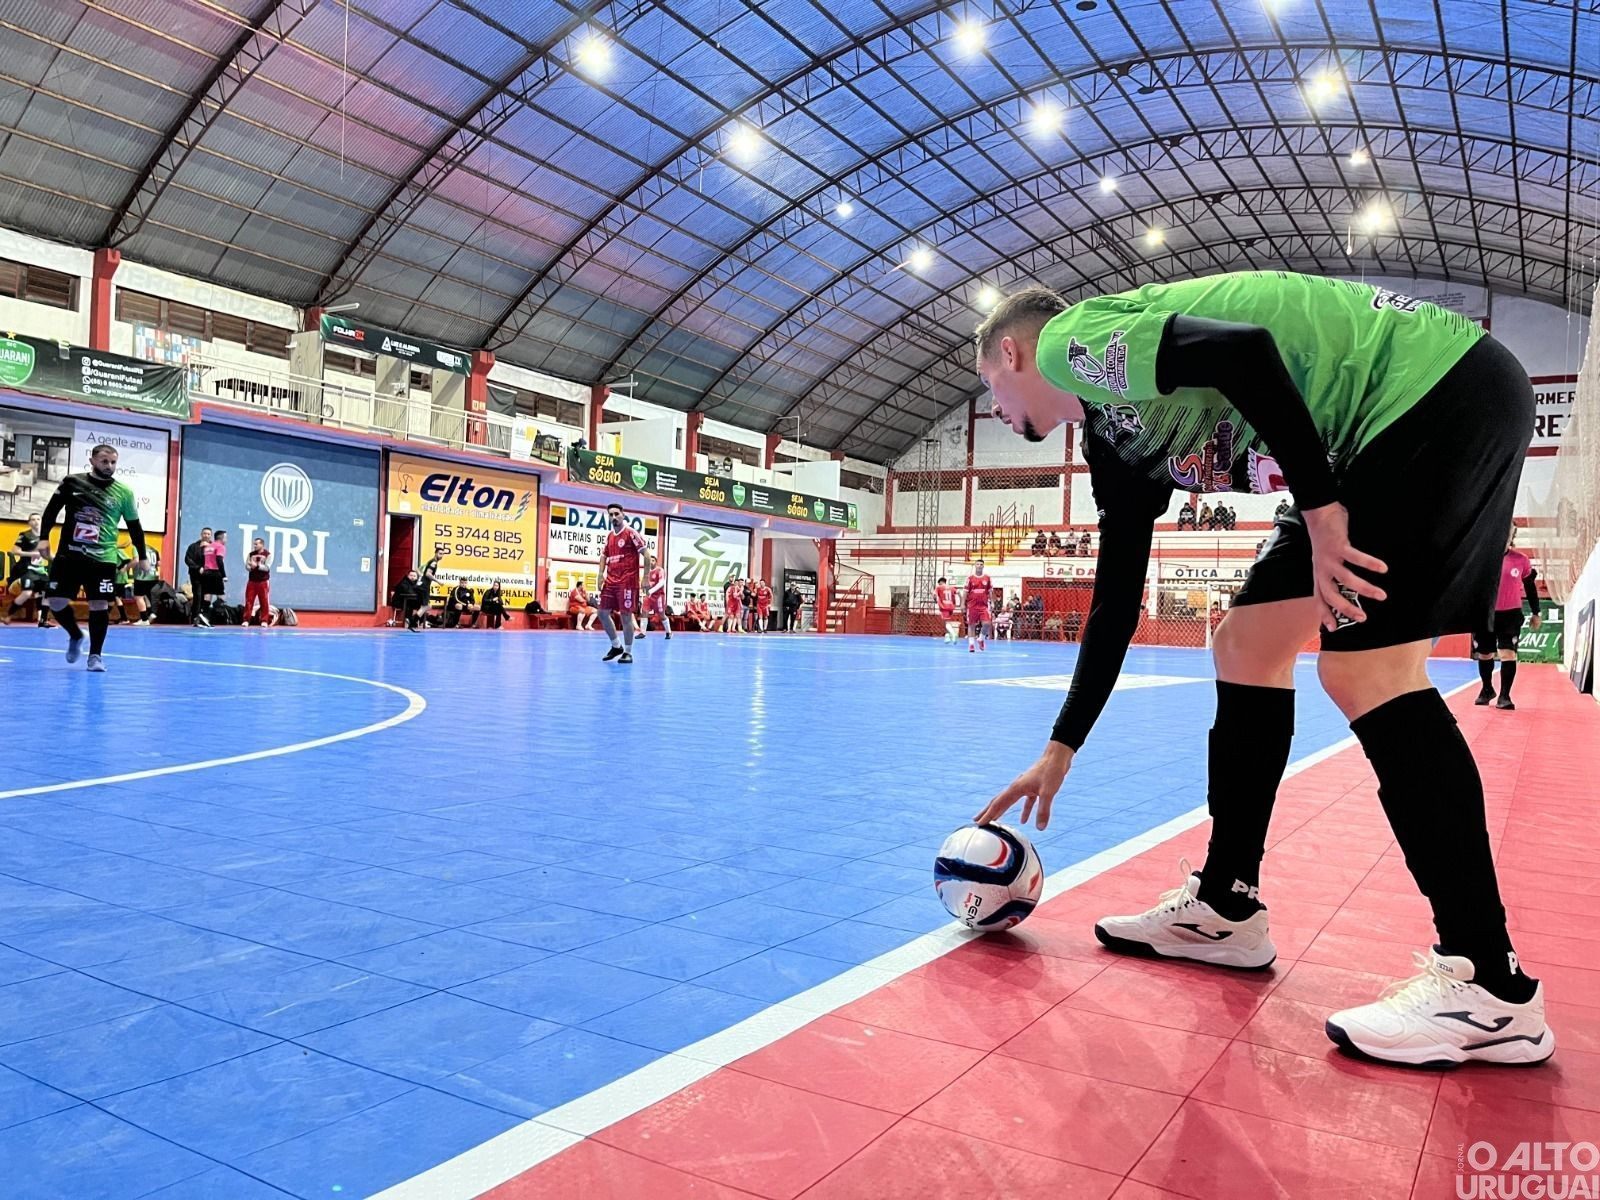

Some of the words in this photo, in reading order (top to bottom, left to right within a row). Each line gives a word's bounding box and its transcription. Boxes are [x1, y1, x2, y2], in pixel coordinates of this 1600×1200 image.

[86, 431, 96, 442] A
[97, 436, 128, 447] gente
[130, 440, 152, 451] ama
[595, 455, 614, 468] SEJA
[116, 466, 138, 478] ocê.
[704, 476, 720, 488] SEJA
[420, 473, 515, 512] Elton
[791, 494, 804, 504] SEJA
[434, 524, 452, 537] 55
[456, 526, 490, 541] 3744
[494, 530, 522, 544] 8125
[550, 529, 592, 543] MATERIAIS
[596, 534, 606, 545] DE
[238, 523, 331, 576] URI
[455, 544, 490, 558] 9962
[493, 547, 525, 561] 3247
[674, 556, 742, 587] ZACA
[556, 570, 599, 591] STE
[477, 588, 533, 598] WPHALEN
[1519, 632, 1550, 648] ANI
